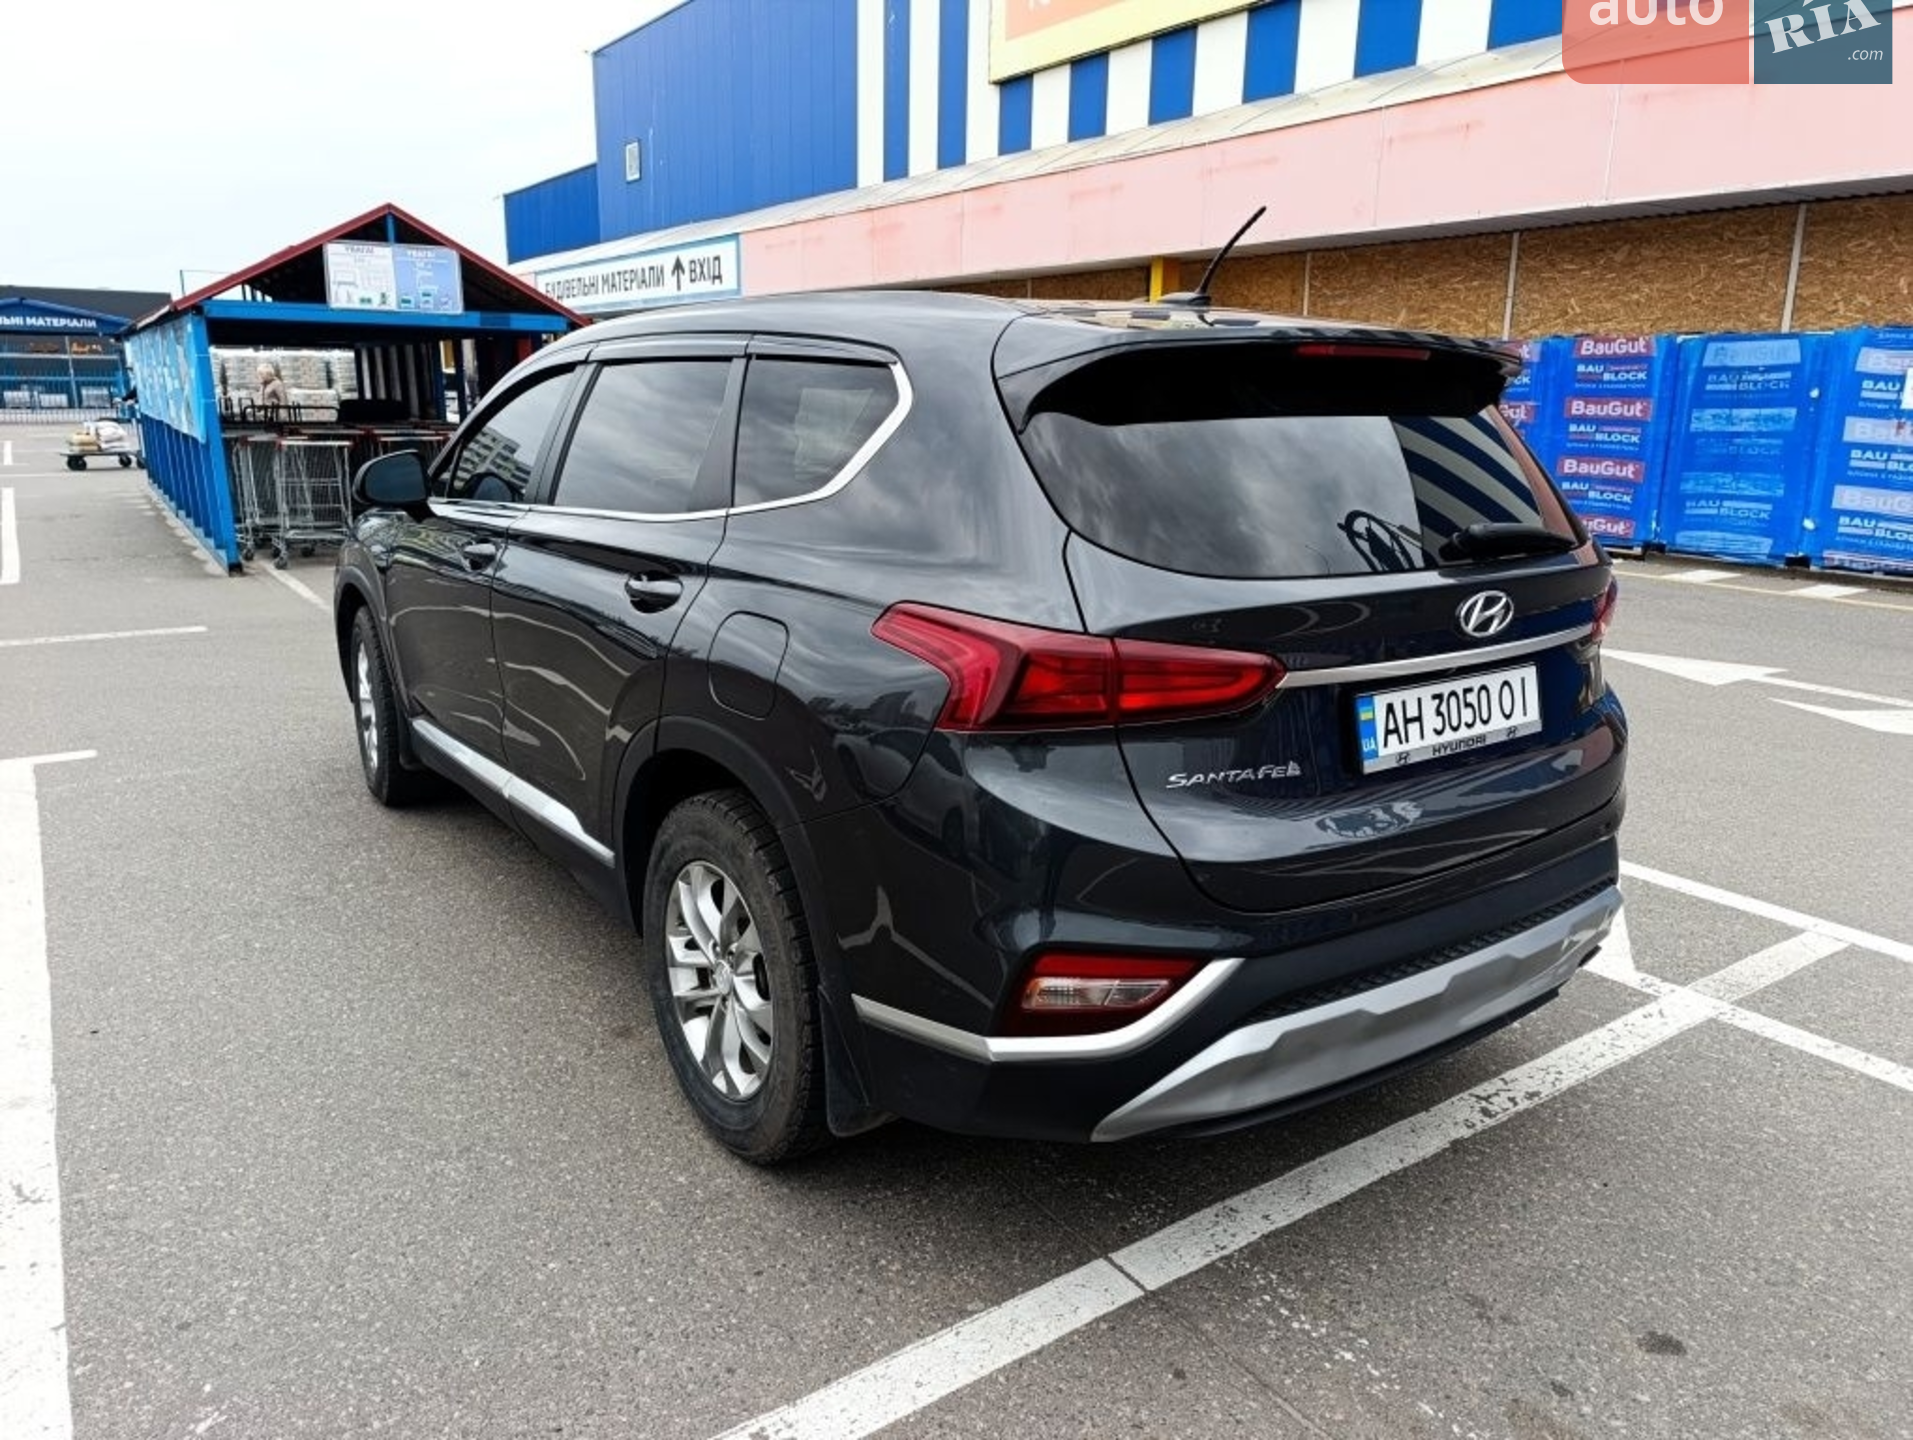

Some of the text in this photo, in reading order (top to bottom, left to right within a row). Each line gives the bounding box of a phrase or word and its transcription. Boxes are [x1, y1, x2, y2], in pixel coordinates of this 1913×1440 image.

[545, 254, 723, 301] БУДІВЕЛЬНІ МАТЕРІАЛИ ВХІД
[26, 316, 98, 329] МАТЕРІАЛИ
[1580, 336, 1649, 356] BauGut
[1576, 364, 1604, 373] BAU
[1603, 371, 1648, 381] BLOCK
[1862, 380, 1900, 391] BAU
[1571, 400, 1645, 417] BauGut
[1569, 423, 1596, 432] BAU
[1595, 433, 1640, 443] BLOCK
[1850, 449, 1888, 461] BAU
[1563, 459, 1637, 478] BauGut
[1562, 481, 1589, 490] BAU
[1588, 491, 1632, 503] BLOCK
[1719, 507, 1771, 520] BLOCK
[1839, 515, 1876, 528] BAU
[1384, 697, 1425, 748] AH
[1431, 684, 1492, 736] 3050
[1362, 738, 1377, 752] UA
[1432, 734, 1486, 757] HYUNDAI
